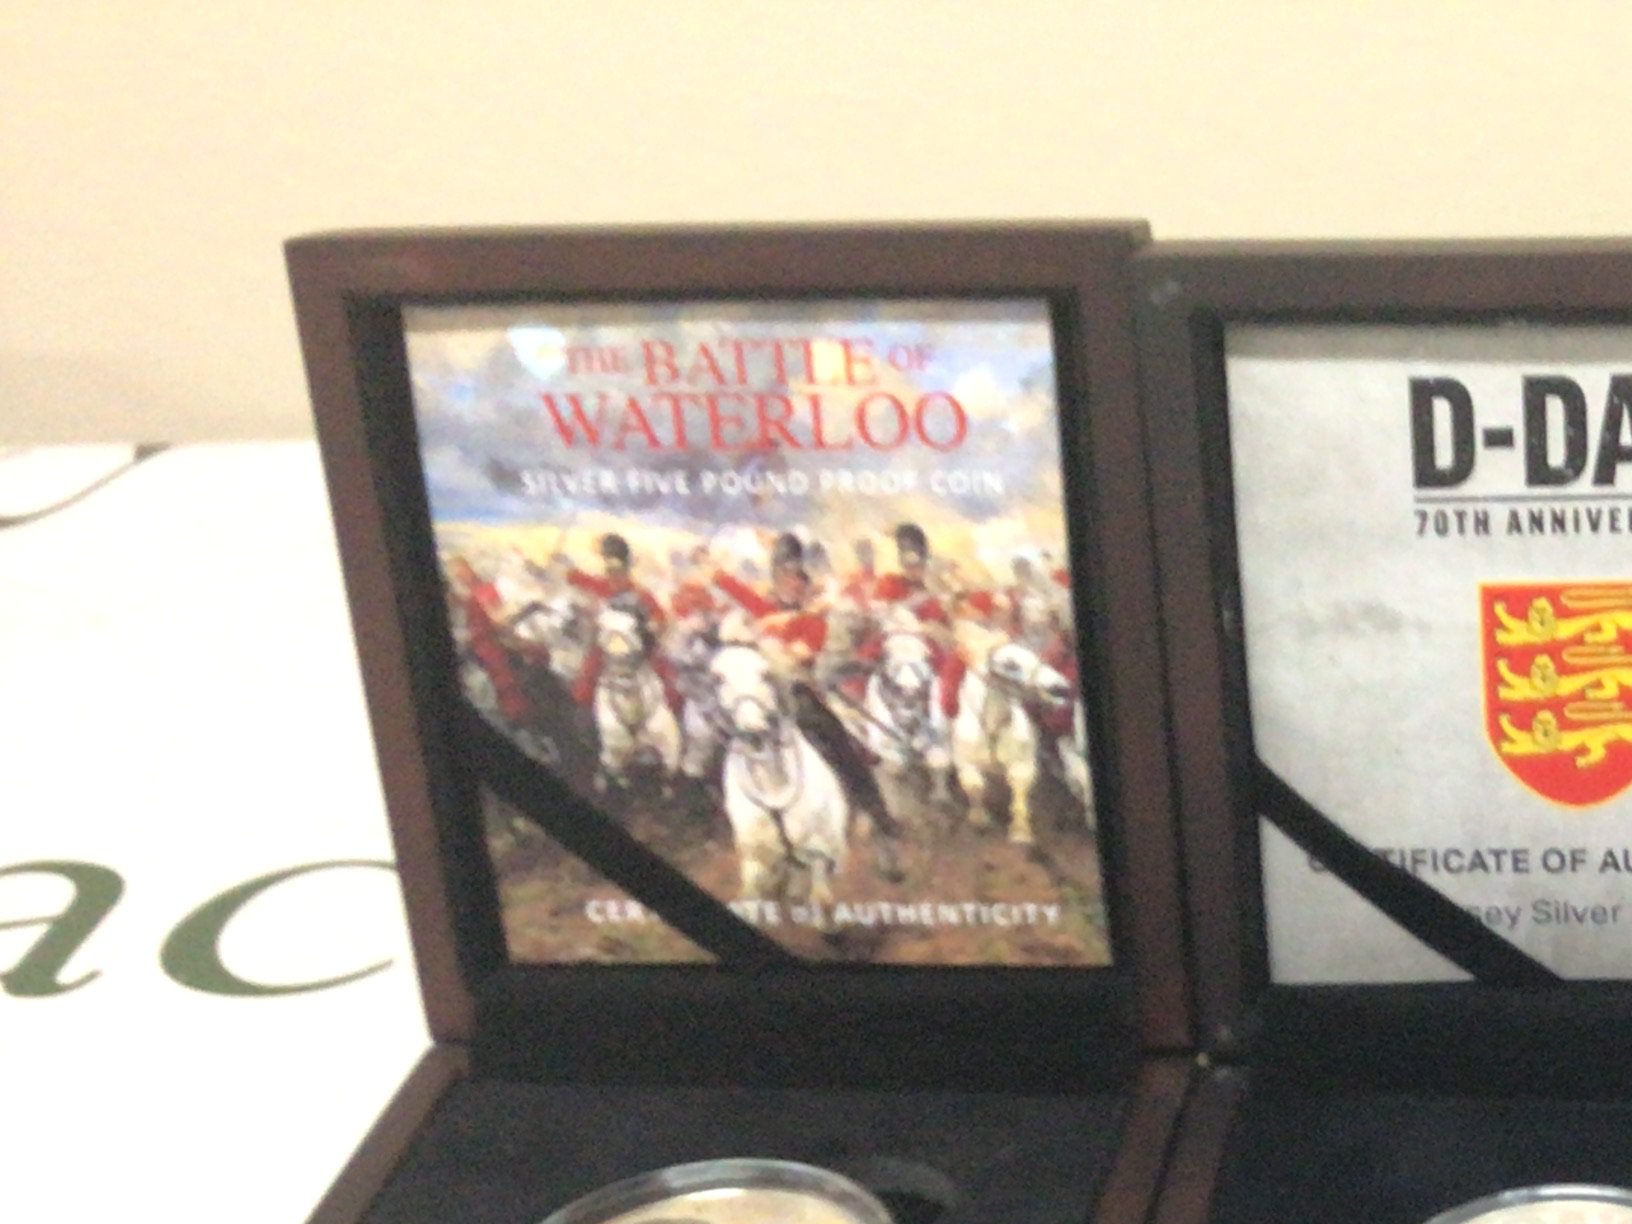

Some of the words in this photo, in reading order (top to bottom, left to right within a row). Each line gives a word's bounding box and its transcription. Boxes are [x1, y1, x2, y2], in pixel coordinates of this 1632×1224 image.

[641, 337, 879, 385] BATTLE
[888, 344, 933, 372] OF
[538, 389, 968, 454] WATERLOO
[521, 469, 625, 497] SILVER
[630, 470, 690, 496] FIVE
[702, 469, 809, 496] POUND
[820, 469, 917, 496] PROOF
[930, 468, 1005, 496] COIN
[1413, 508, 1491, 538] 70TH
[1541, 847, 1587, 874] OF
[833, 901, 1062, 928] AUTHENTICITY
[1530, 896, 1619, 925] Silver
